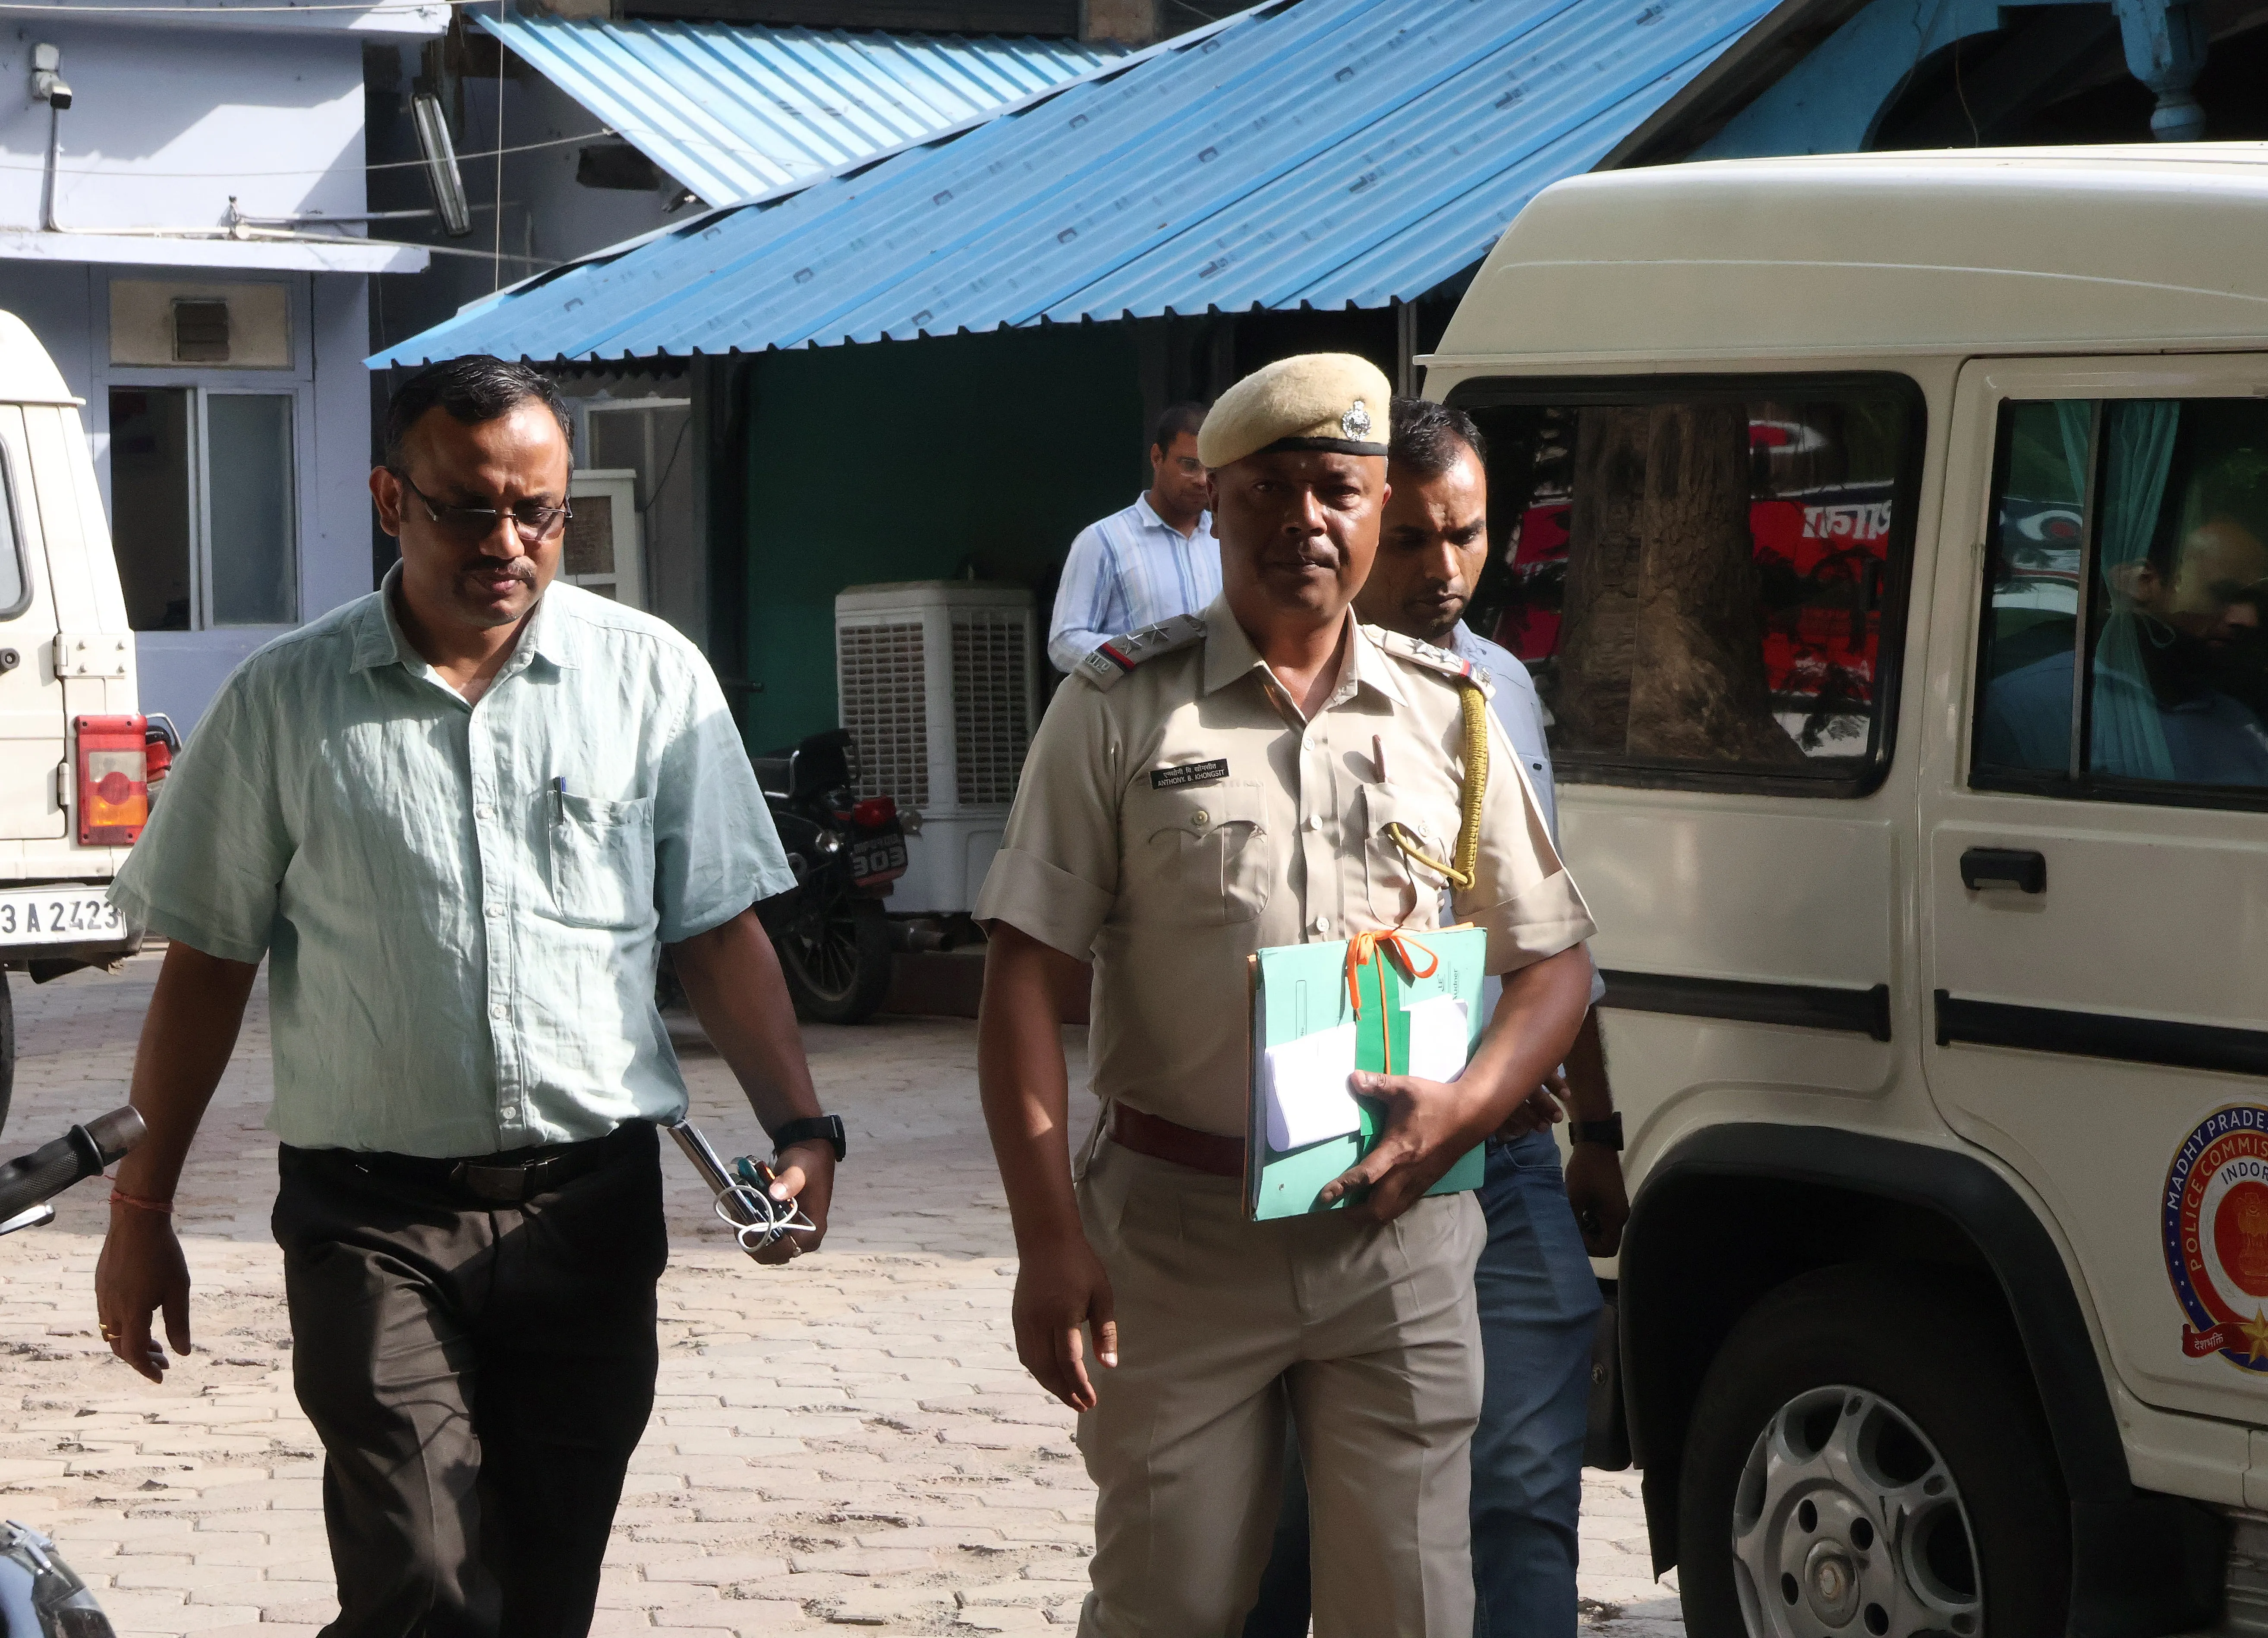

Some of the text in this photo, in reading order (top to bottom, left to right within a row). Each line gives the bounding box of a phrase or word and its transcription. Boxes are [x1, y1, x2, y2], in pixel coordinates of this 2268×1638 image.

[2167, 1109, 2268, 1210] MADHY PRADE
[2185, 1178, 2204, 1272] POLICE
